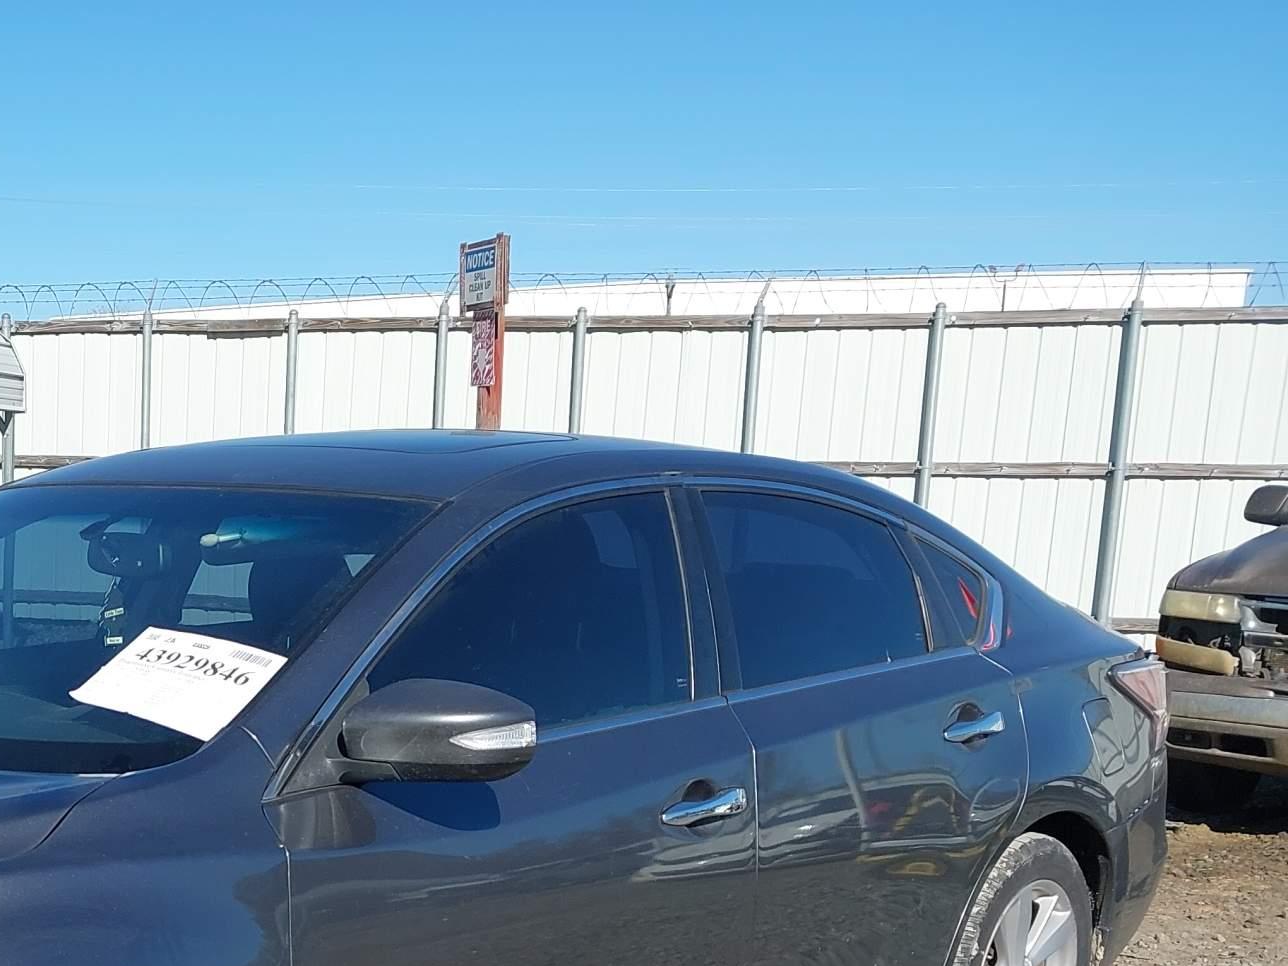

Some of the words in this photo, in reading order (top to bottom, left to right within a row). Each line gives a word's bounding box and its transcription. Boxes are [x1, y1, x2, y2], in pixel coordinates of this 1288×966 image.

[467, 249, 495, 270] NOTICE
[474, 271, 487, 282] SPILL
[469, 282, 484, 293] CLEAN
[485, 280, 492, 290] UP
[135, 647, 256, 686] 43929846
